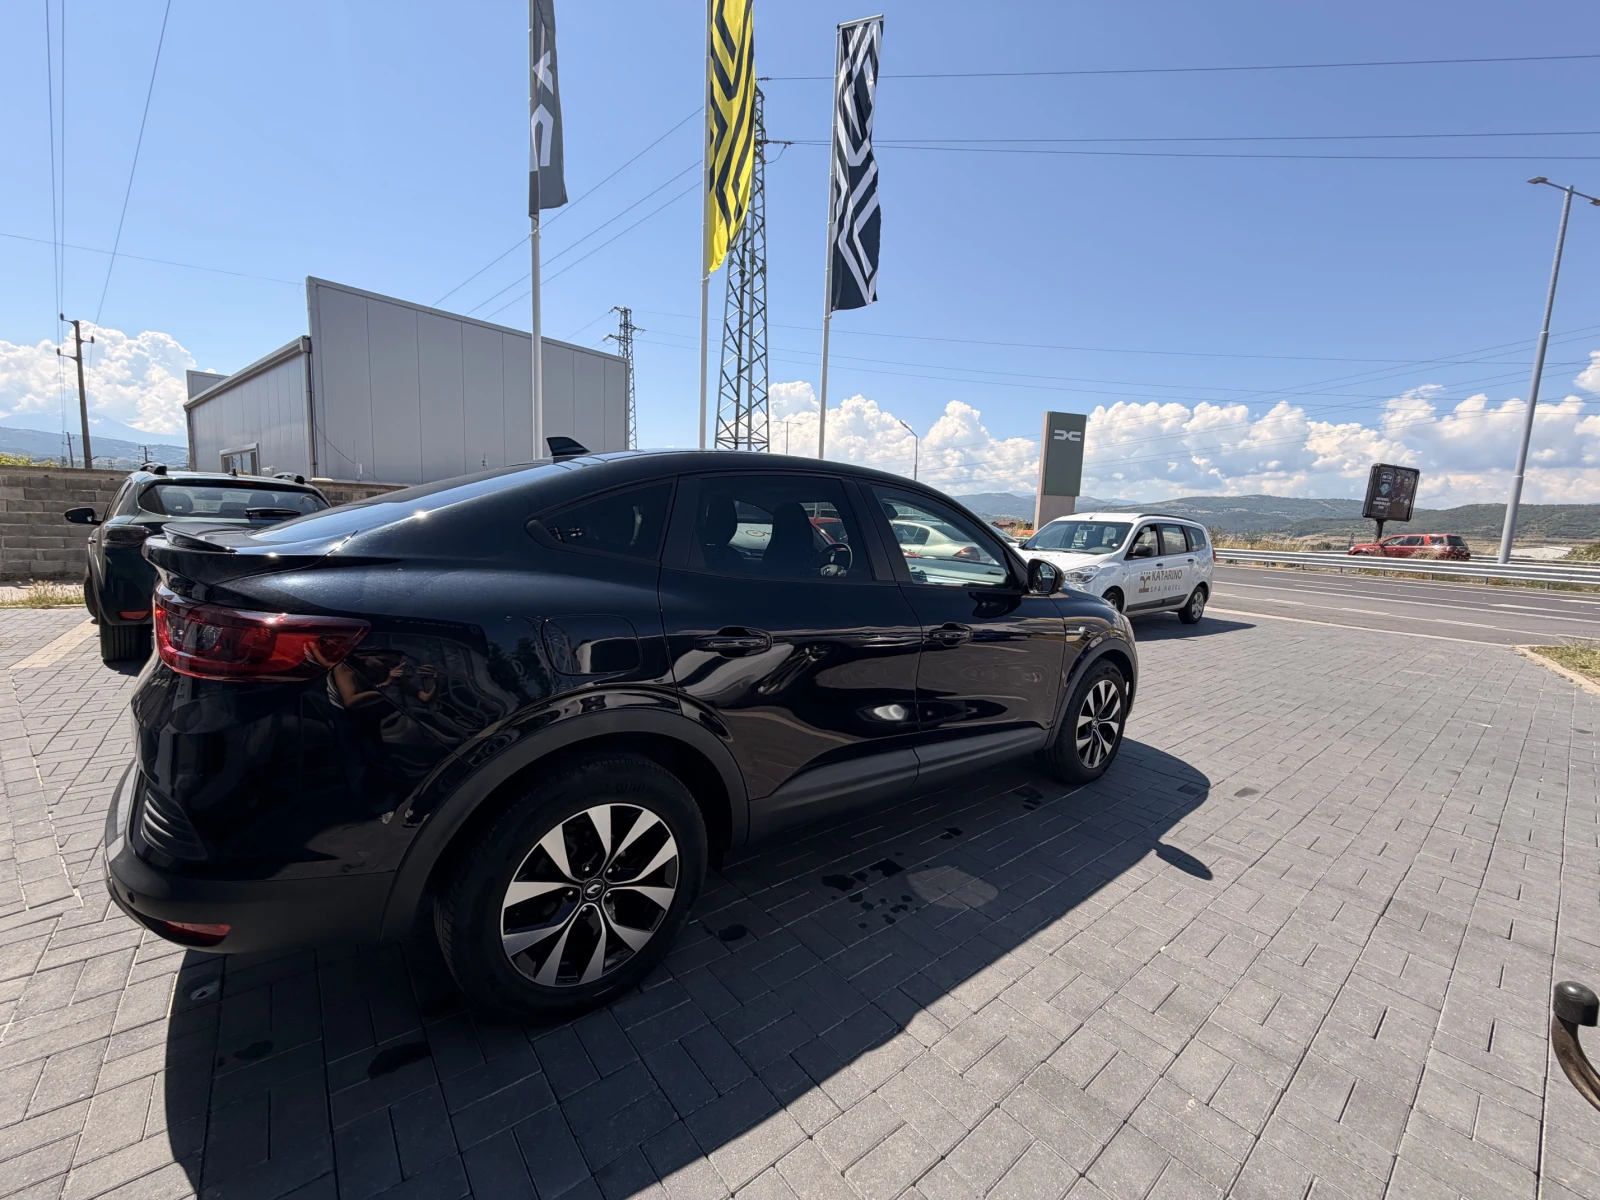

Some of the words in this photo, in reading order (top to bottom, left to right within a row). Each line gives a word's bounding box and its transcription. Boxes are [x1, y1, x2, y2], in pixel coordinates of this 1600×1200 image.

[1151, 569, 1183, 581] KATARINO
[1150, 585, 1161, 593] SPA
[1163, 584, 1181, 592] HOTEL
